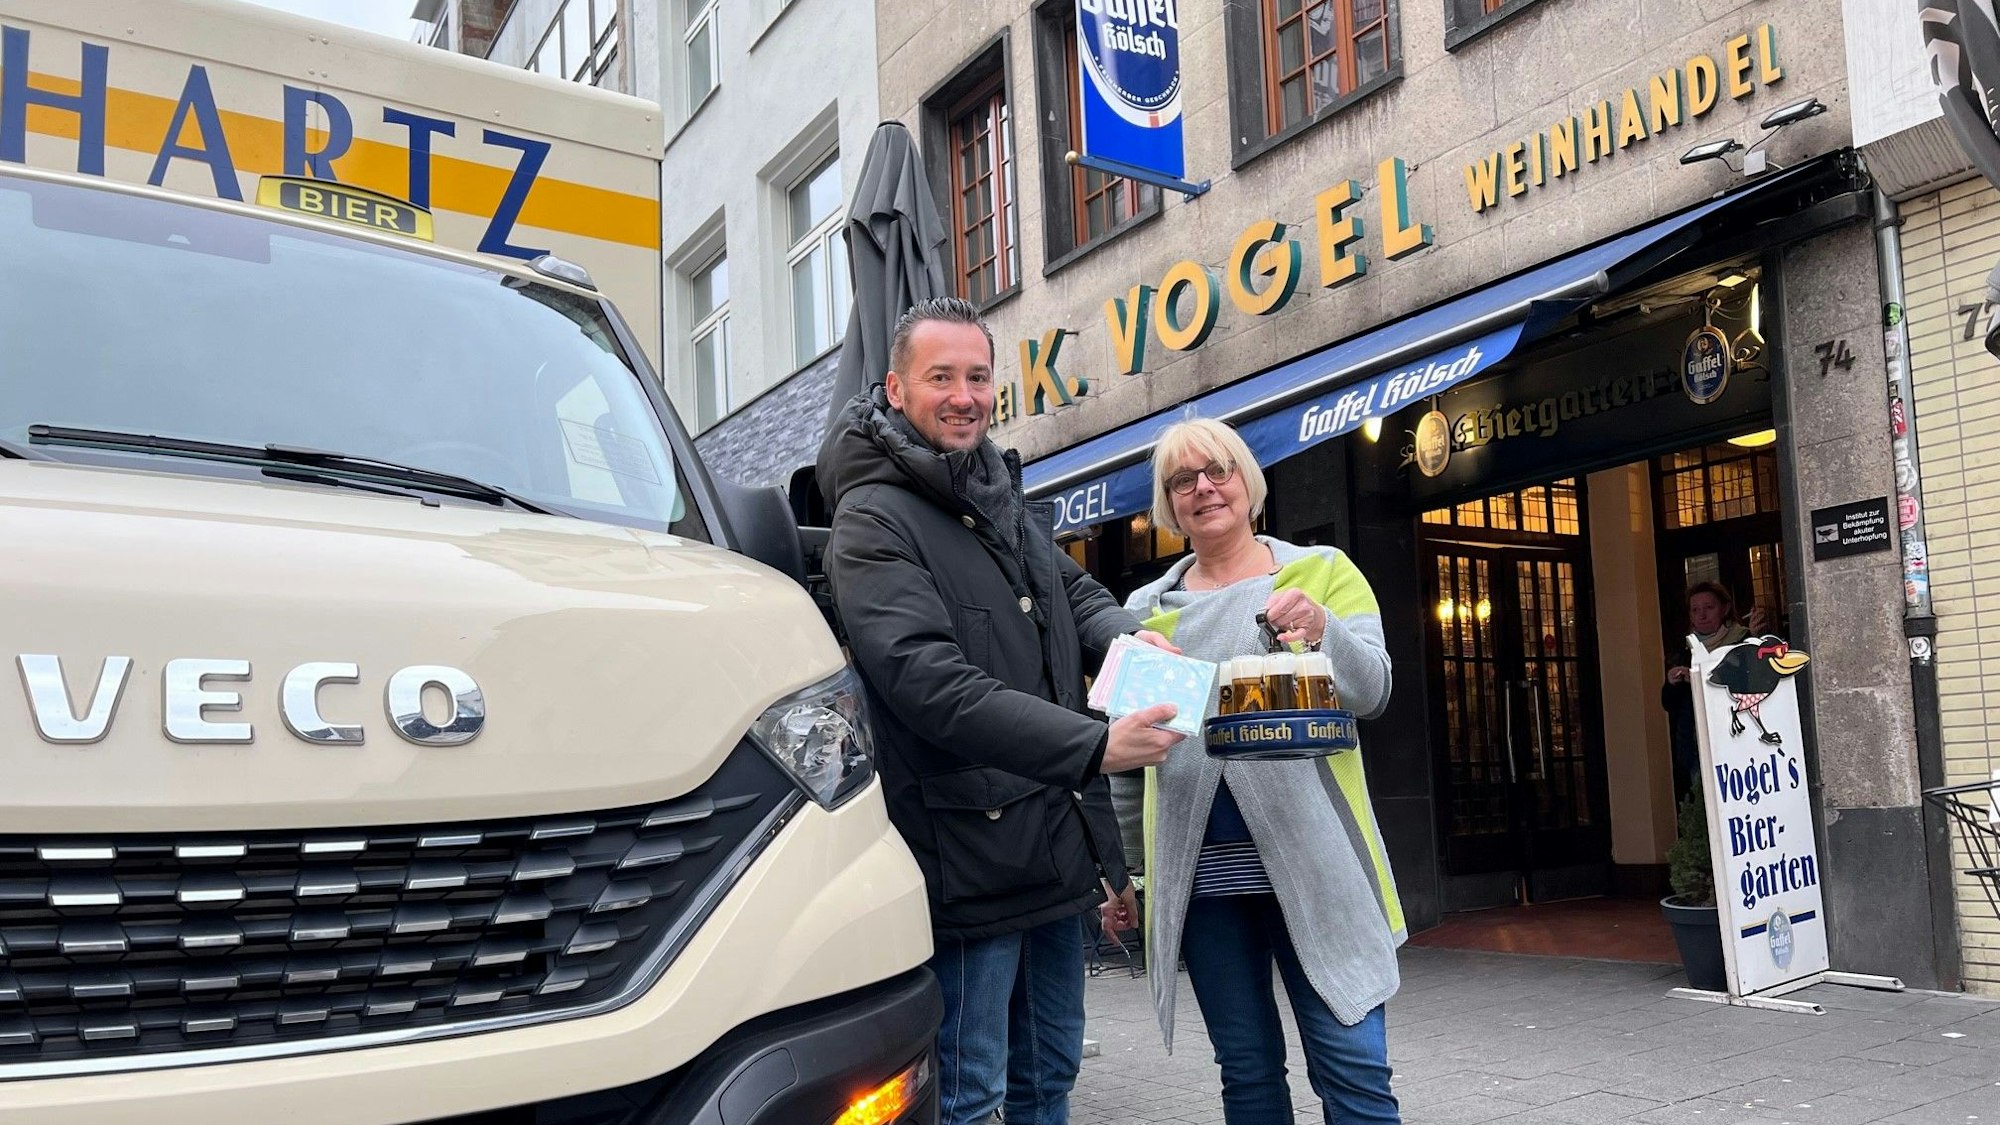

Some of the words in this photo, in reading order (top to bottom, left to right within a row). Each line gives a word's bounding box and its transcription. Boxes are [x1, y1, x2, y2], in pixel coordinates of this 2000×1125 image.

[1101, 22, 1167, 60] Kölsch
[0, 25, 551, 260] HARTZ
[299, 186, 400, 230] BIER
[989, 381, 1018, 429] EI
[1019, 328, 1089, 416] K.
[1105, 156, 1433, 376] VOGEL
[1463, 23, 1785, 212] WEINHANDEL
[1687, 353, 1722, 375] Gaffel
[1814, 340, 1856, 375] 74
[1299, 383, 1378, 442] Gaffel
[1380, 346, 1483, 409] Kölsch
[1453, 367, 1656, 447] Biergarten
[1842, 517, 1884, 529] Bekämpfung
[1845, 511, 1868, 521] Institut
[1869, 509, 1880, 517] zur
[1853, 526, 1875, 535] akuter
[1842, 532, 1888, 545] Unterhopfung
[1239, 722, 1292, 742] Kölsch
[1307, 721, 1345, 740] Gaffel
[1728, 815, 1785, 857] Bier-
[1740, 852, 1816, 910] garten
